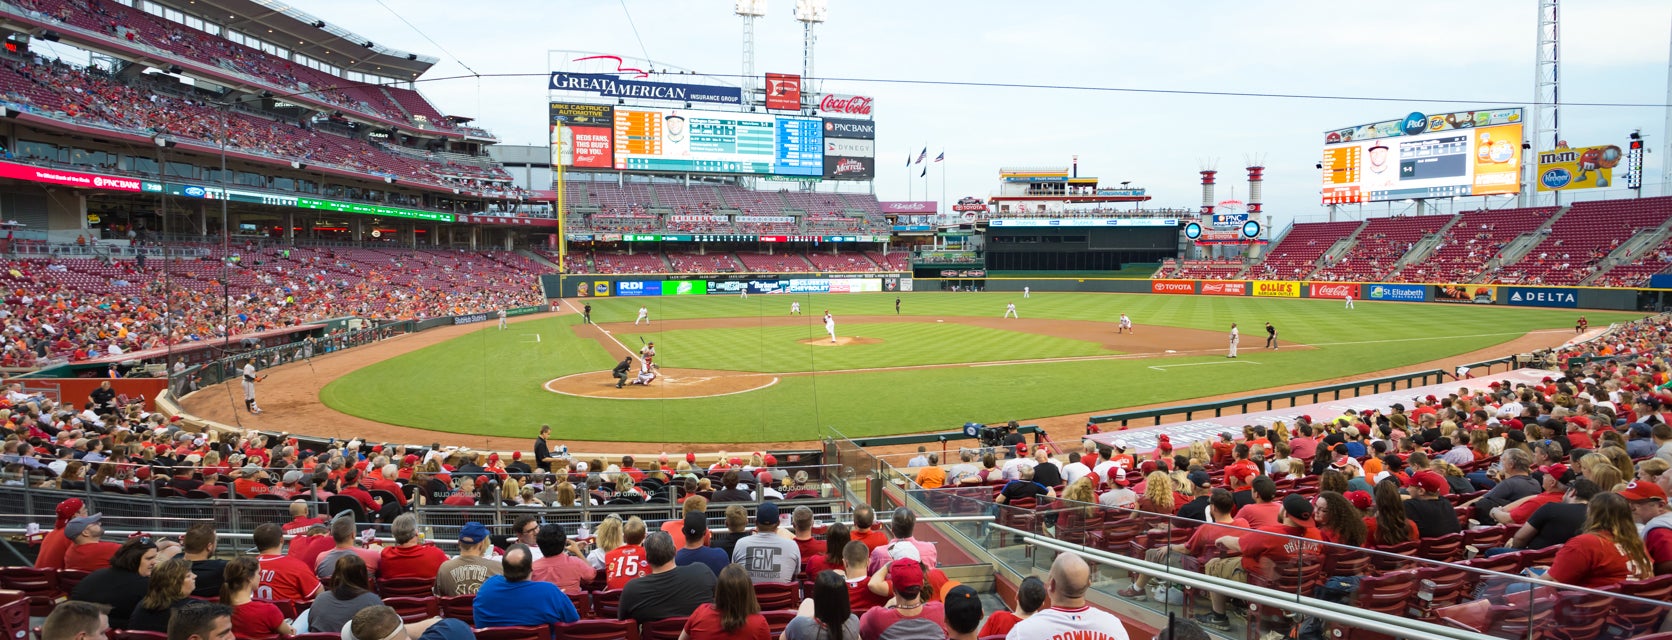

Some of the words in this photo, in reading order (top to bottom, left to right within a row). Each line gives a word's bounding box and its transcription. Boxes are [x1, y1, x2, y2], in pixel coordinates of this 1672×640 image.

[690, 94, 719, 102] INSURANCE
[720, 95, 739, 103] GROUP
[820, 94, 872, 115] Coca-Cola
[1406, 118, 1425, 129] P&G
[620, 281, 643, 289] RDI
[1526, 291, 1574, 302] DELTA
[615, 555, 639, 577] 15
[450, 565, 487, 583] VOTTO
